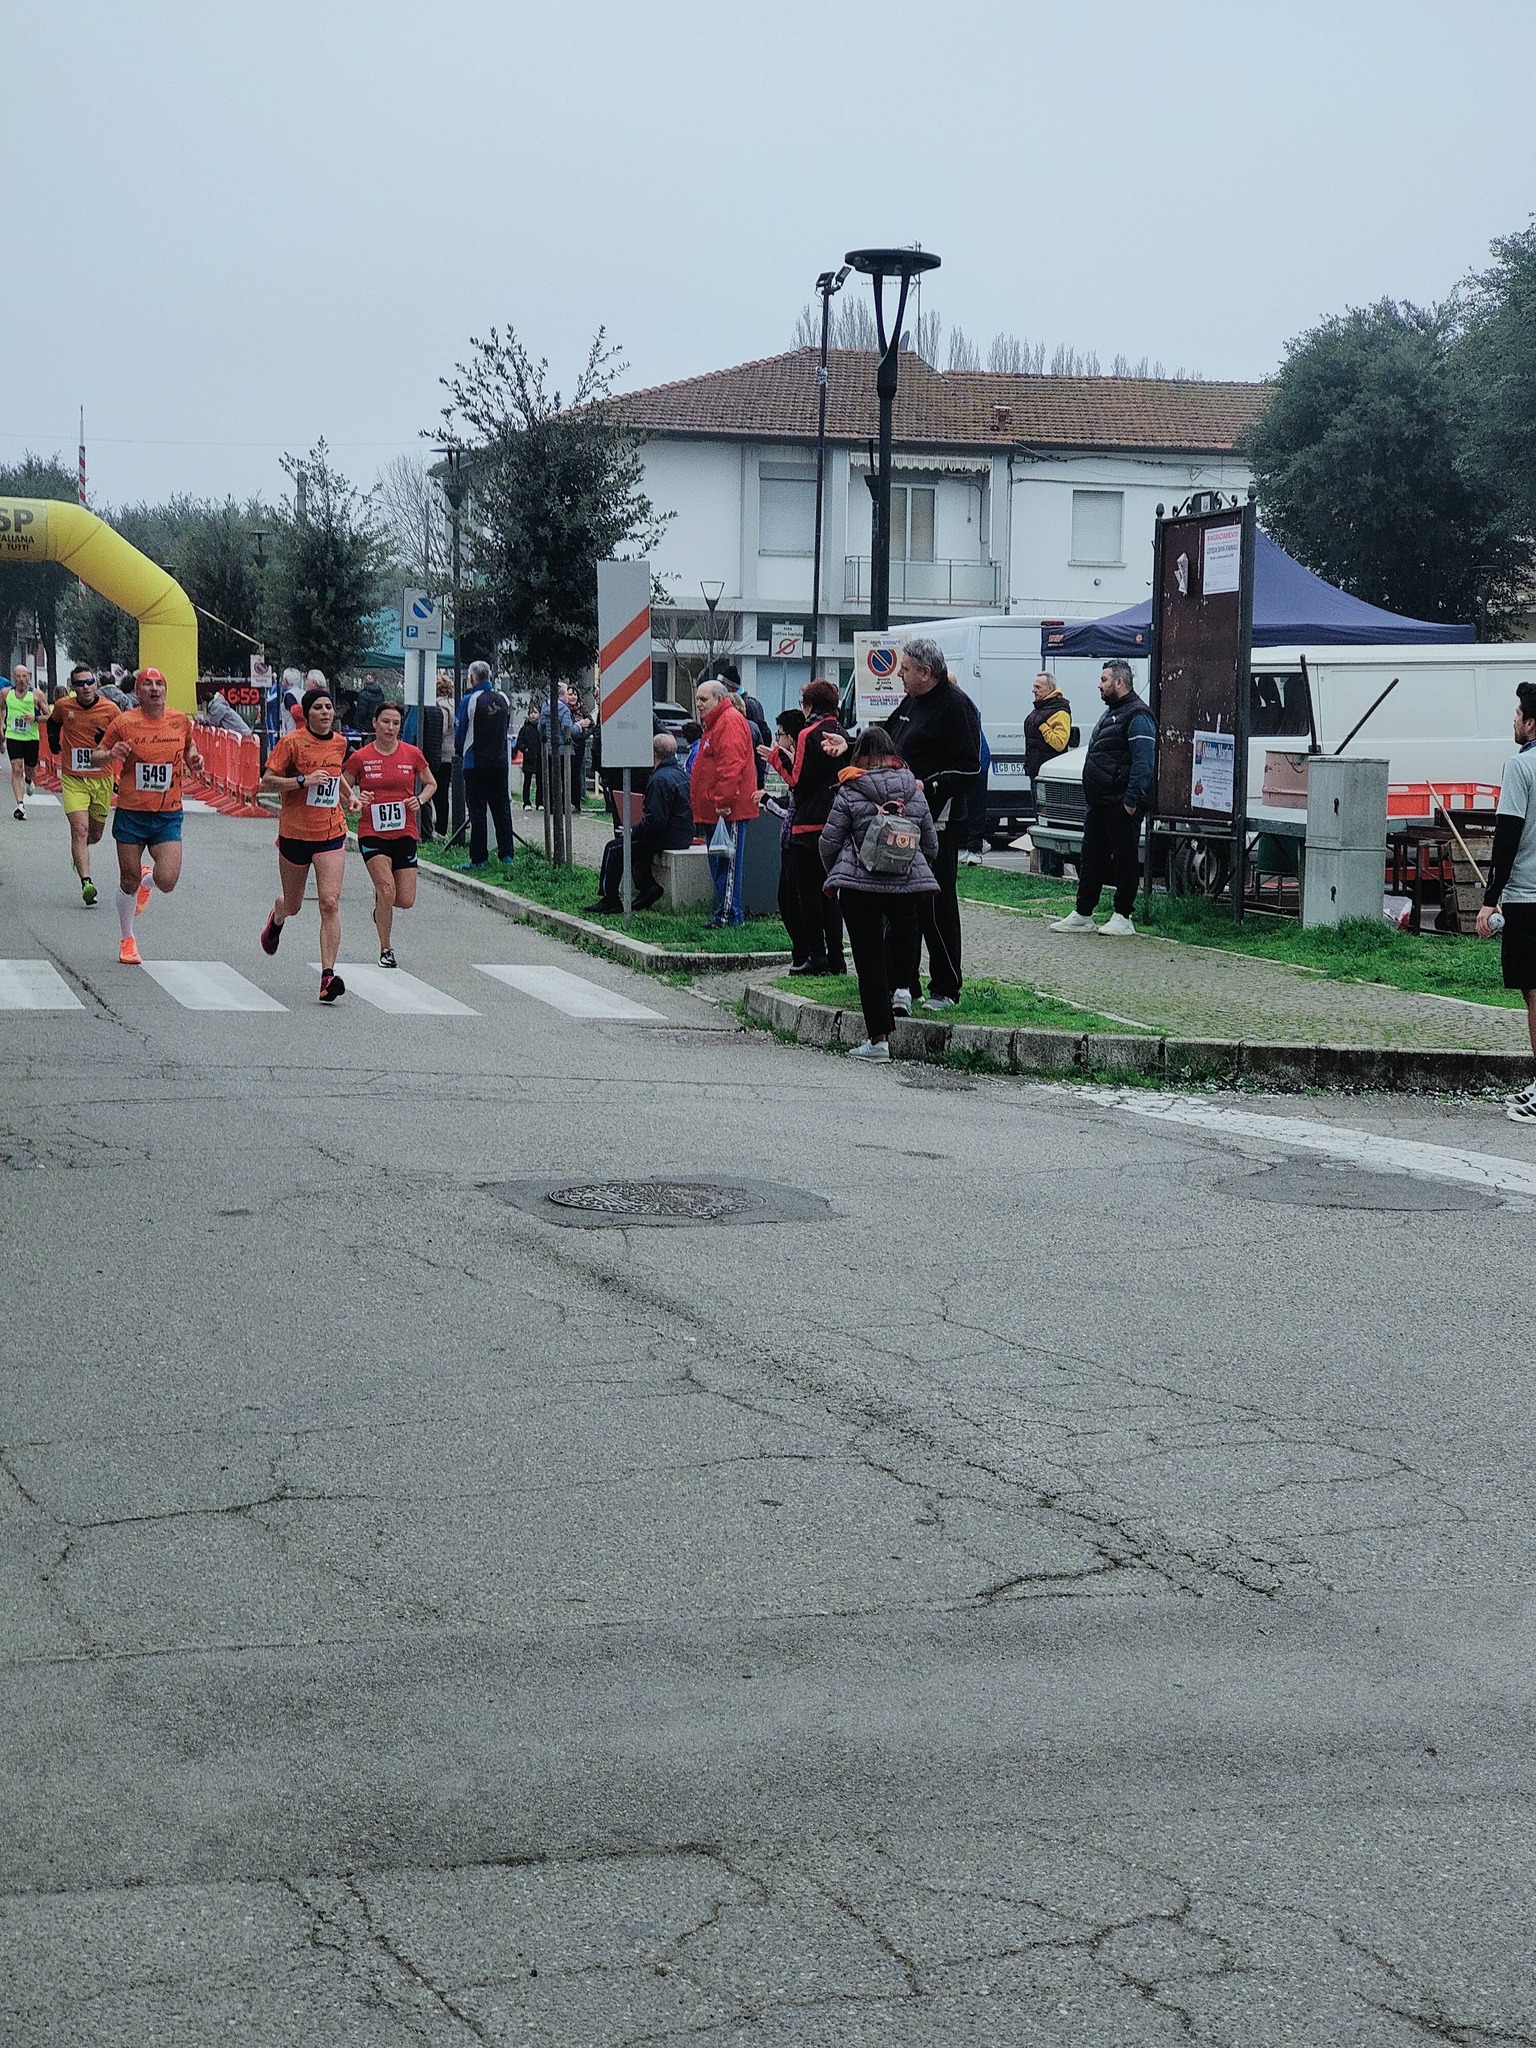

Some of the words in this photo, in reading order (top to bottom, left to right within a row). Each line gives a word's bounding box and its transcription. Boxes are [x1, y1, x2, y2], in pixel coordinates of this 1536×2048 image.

[0, 534, 35, 544] ALIANA
[142, 764, 167, 782] 549
[379, 803, 402, 821] 675
